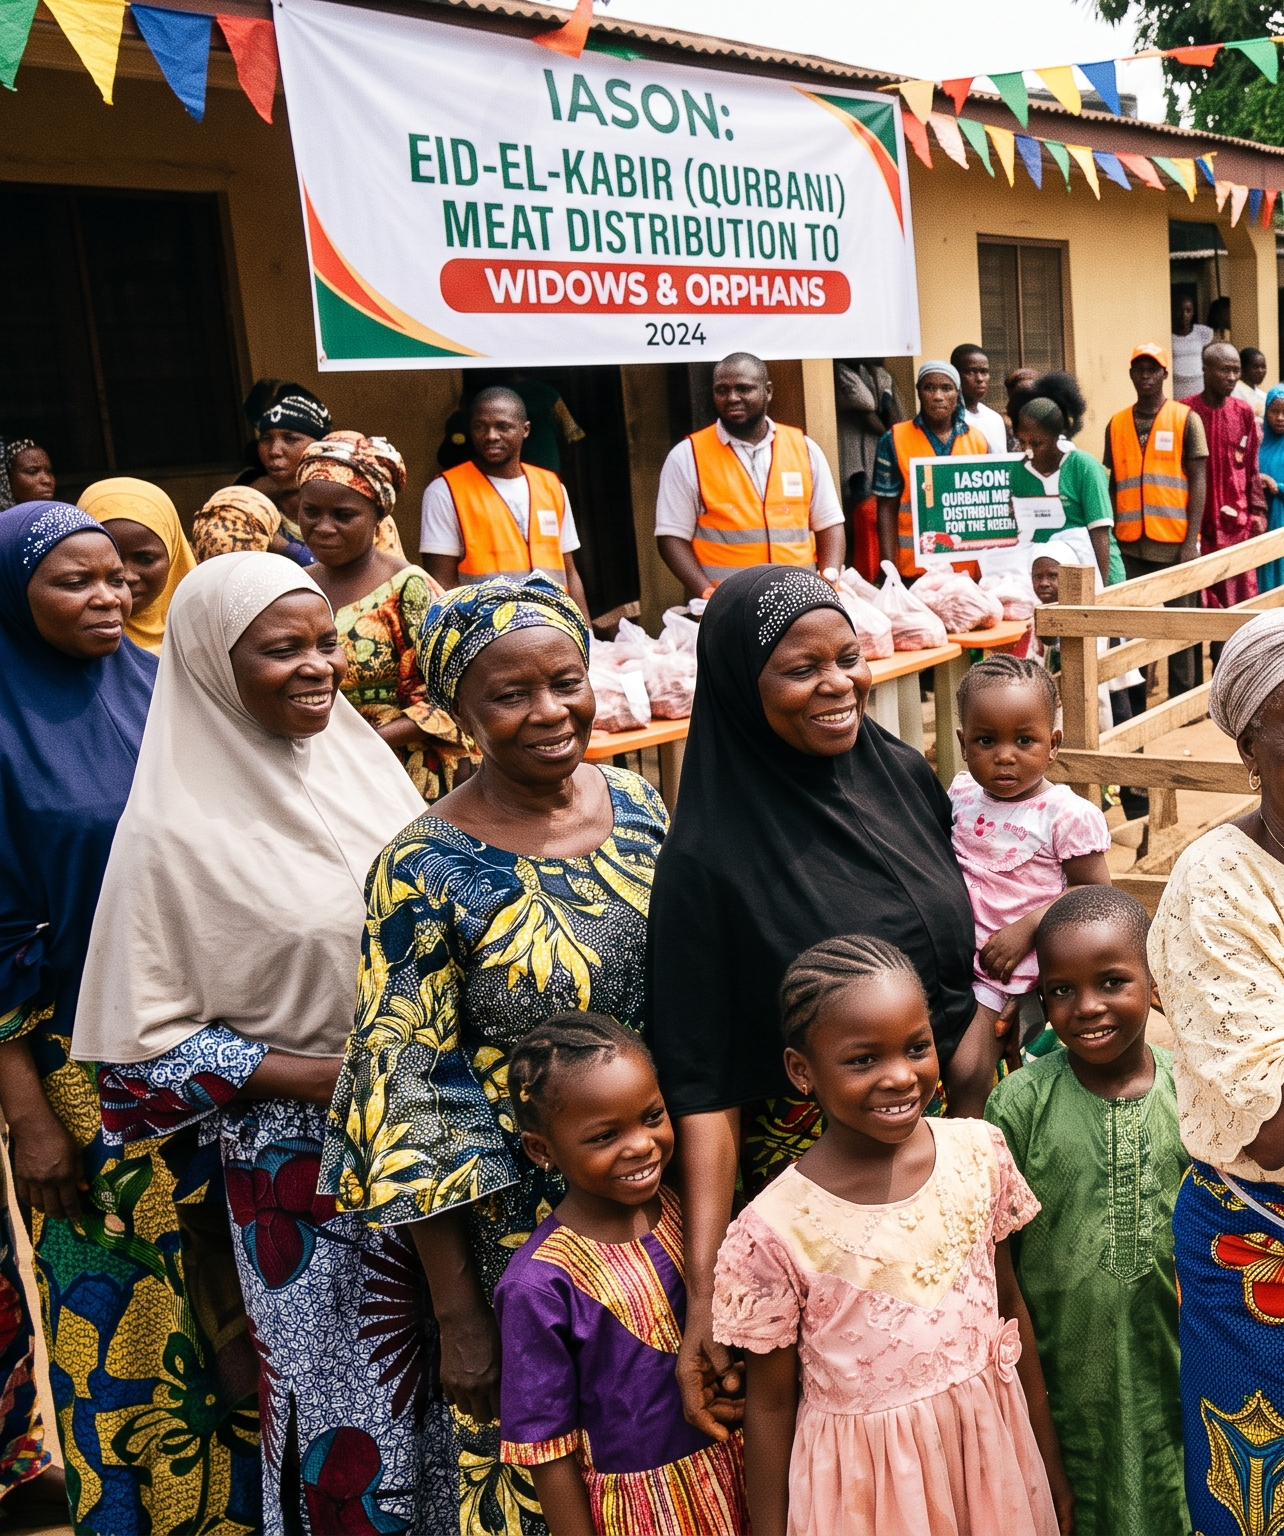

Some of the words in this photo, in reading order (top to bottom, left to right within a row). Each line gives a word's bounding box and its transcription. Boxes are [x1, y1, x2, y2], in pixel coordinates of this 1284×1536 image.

[543, 68, 734, 141] IASON:
[408, 133, 674, 201] EID-EL-KABIR
[684, 158, 846, 219] (QURBANI)
[442, 199, 554, 250] MEAT
[565, 207, 797, 261] DISTRIBUTION
[804, 223, 840, 263] TO
[484, 267, 649, 306] WIDOWS
[656, 272, 679, 306] &
[685, 273, 827, 307] ORPHANS
[645, 322, 707, 346] 2024
